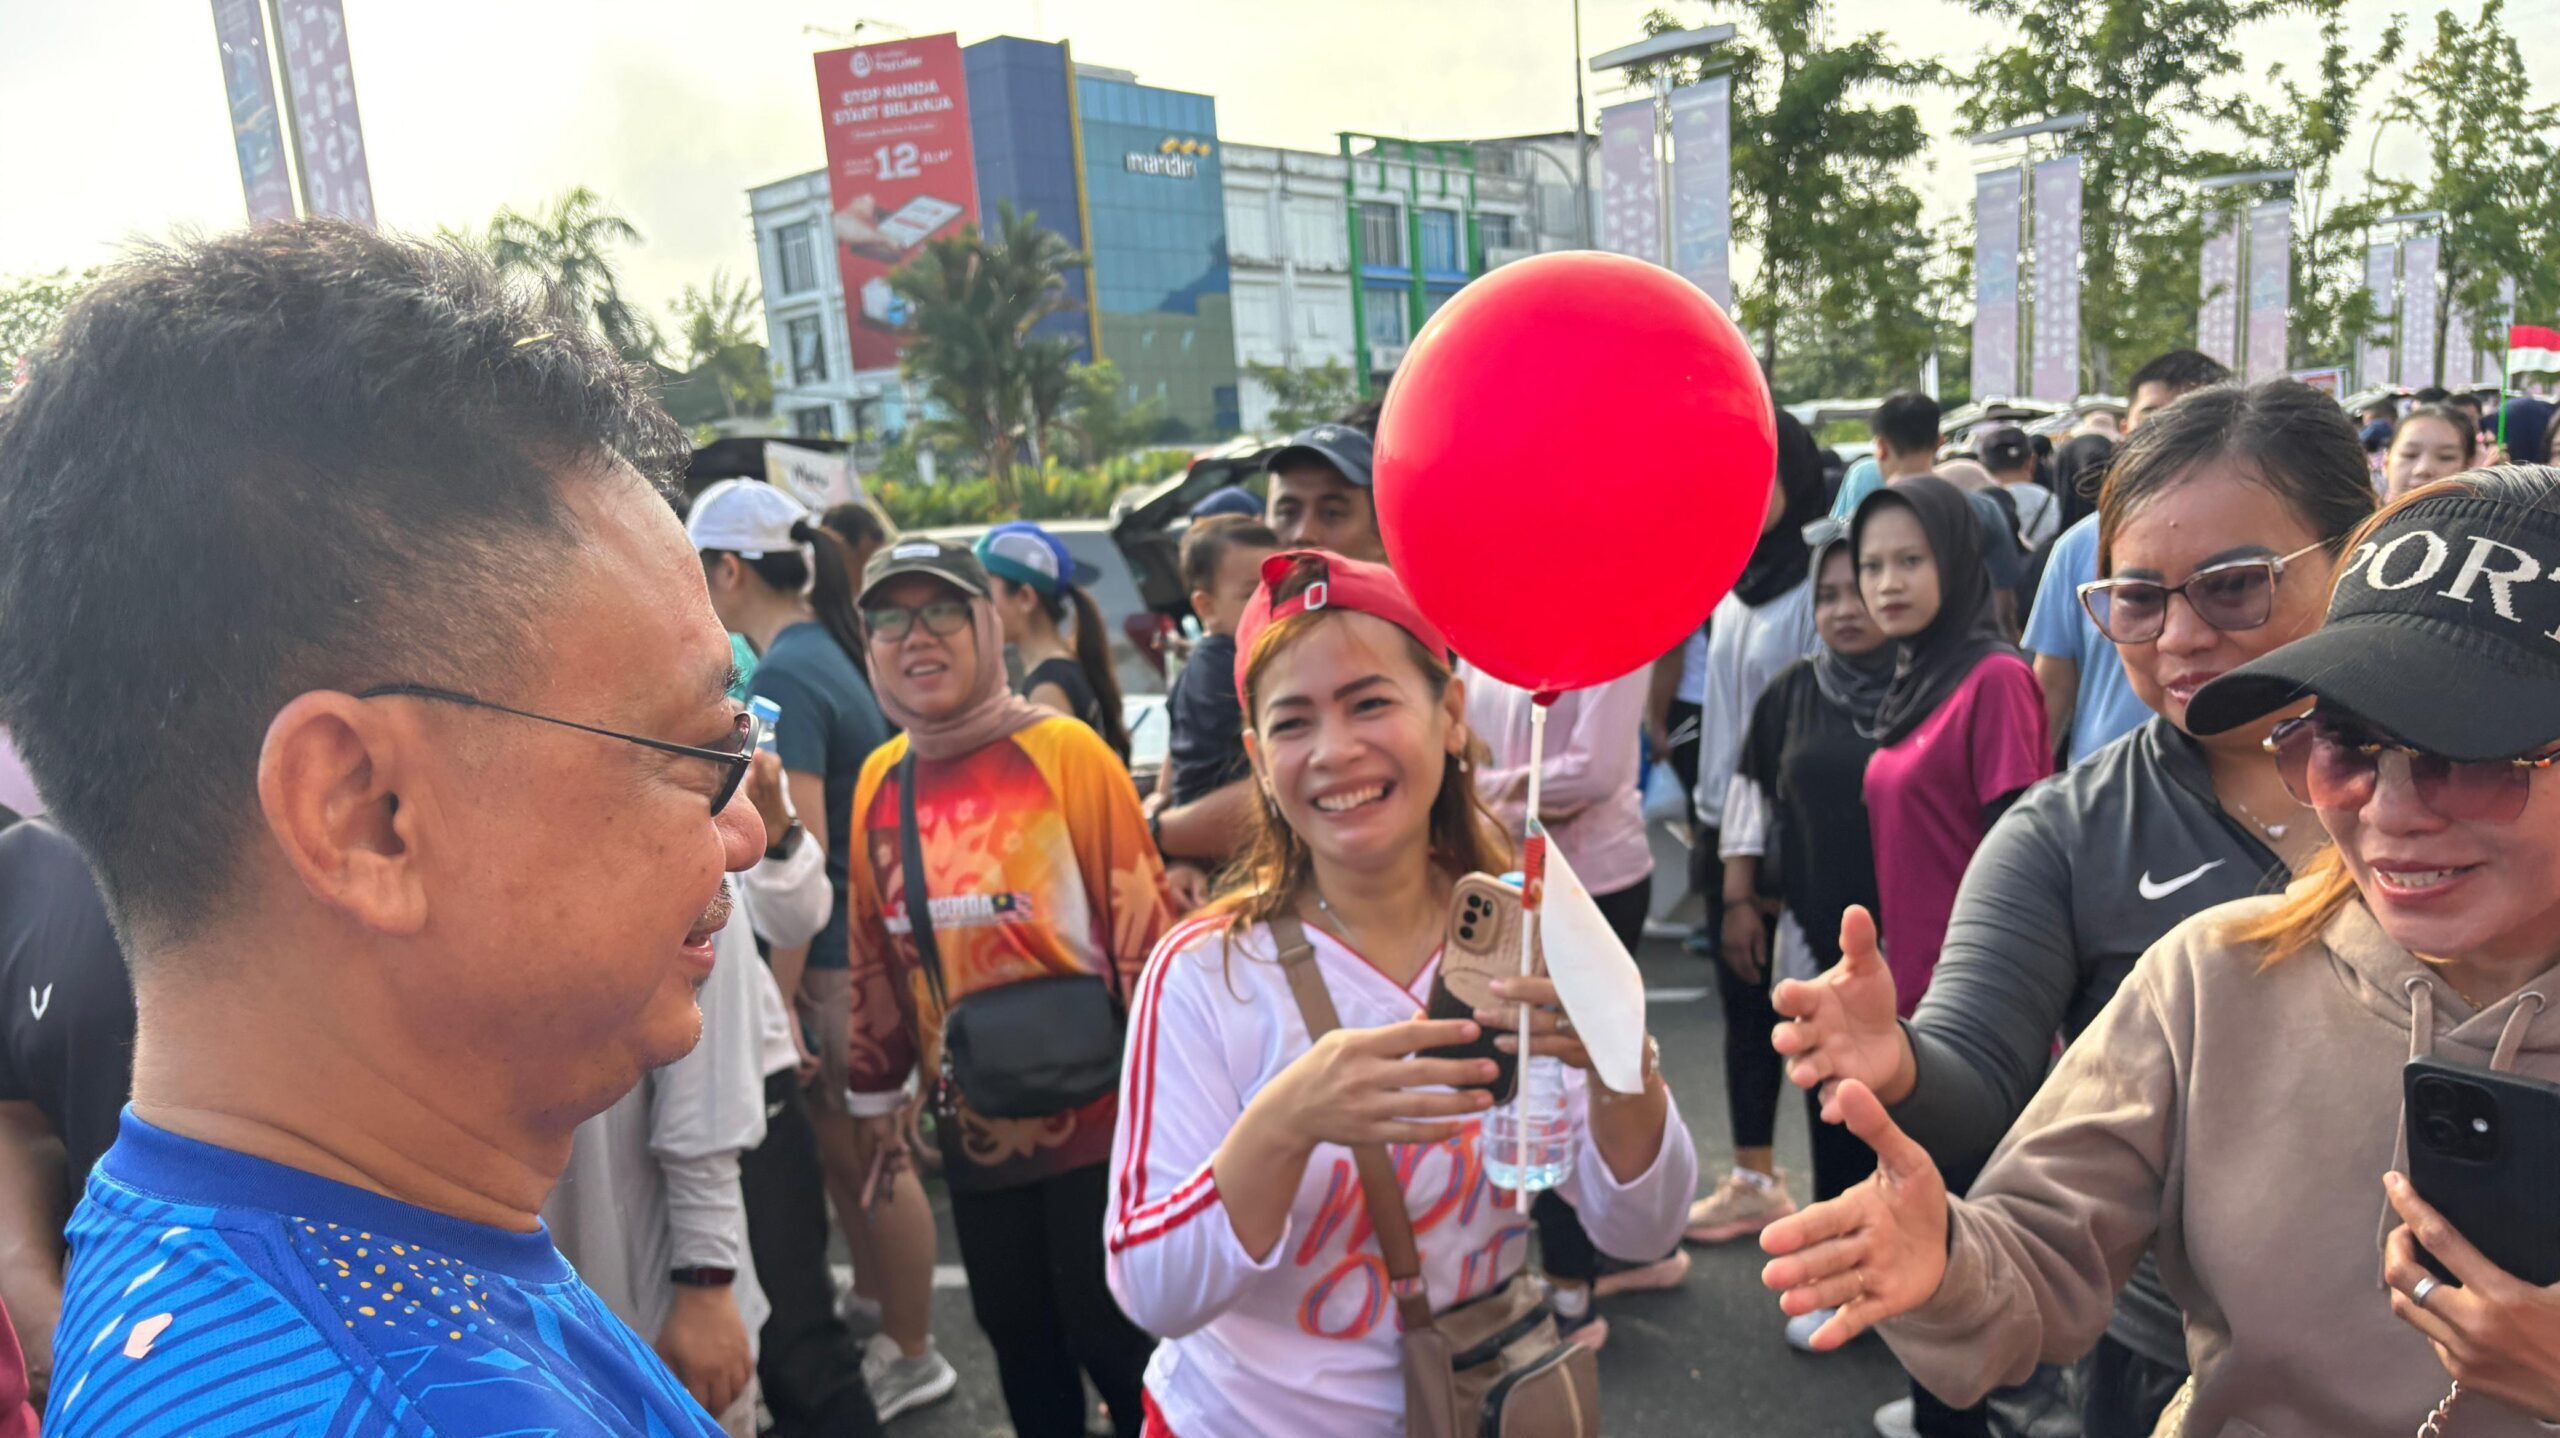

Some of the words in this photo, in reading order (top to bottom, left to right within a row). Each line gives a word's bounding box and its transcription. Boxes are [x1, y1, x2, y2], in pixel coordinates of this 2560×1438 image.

[833, 105, 878, 125] START
[882, 96, 953, 118] BELANJA
[875, 142, 921, 180] 12
[1125, 151, 1197, 178] mandiri
[2328, 530, 2560, 643] POR
